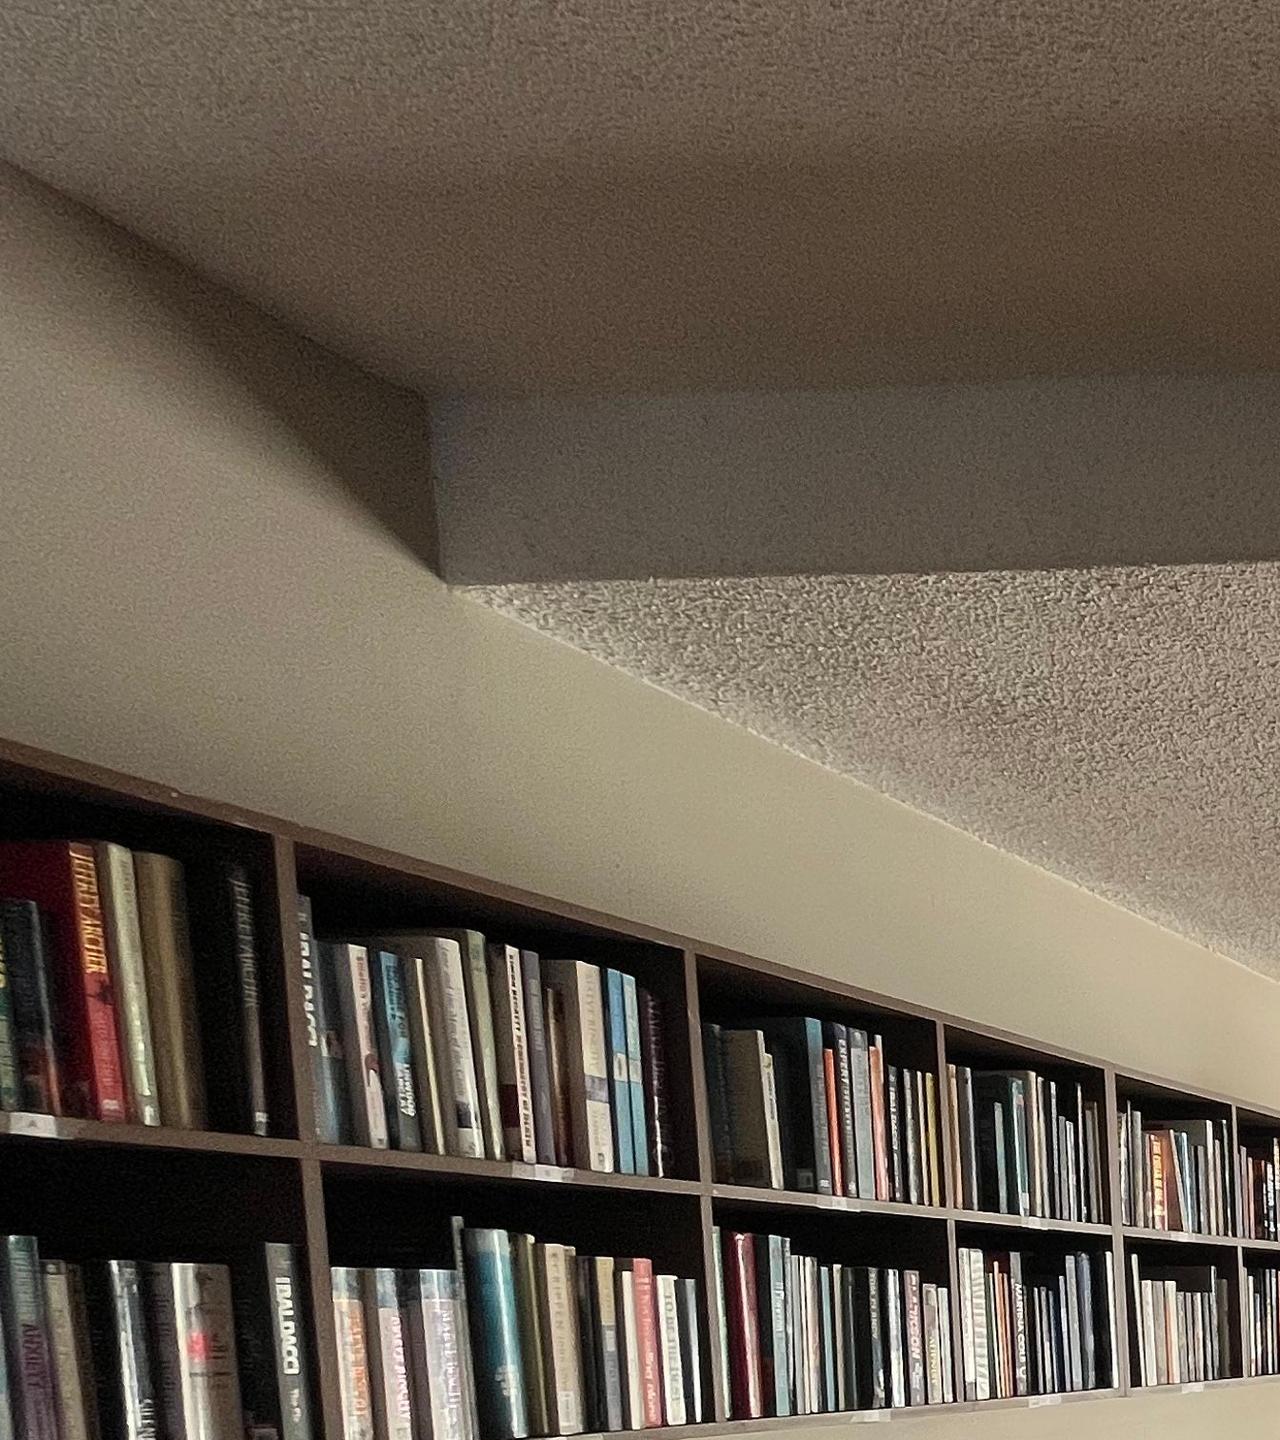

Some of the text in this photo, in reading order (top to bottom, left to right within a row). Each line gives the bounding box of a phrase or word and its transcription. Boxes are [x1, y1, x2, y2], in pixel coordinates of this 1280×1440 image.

[71, 853, 107, 974] JEFFREY ARCHER
[229, 879, 260, 1009] JEFFREY ARCHER
[1014, 1283, 1024, 1332] MARTINA
